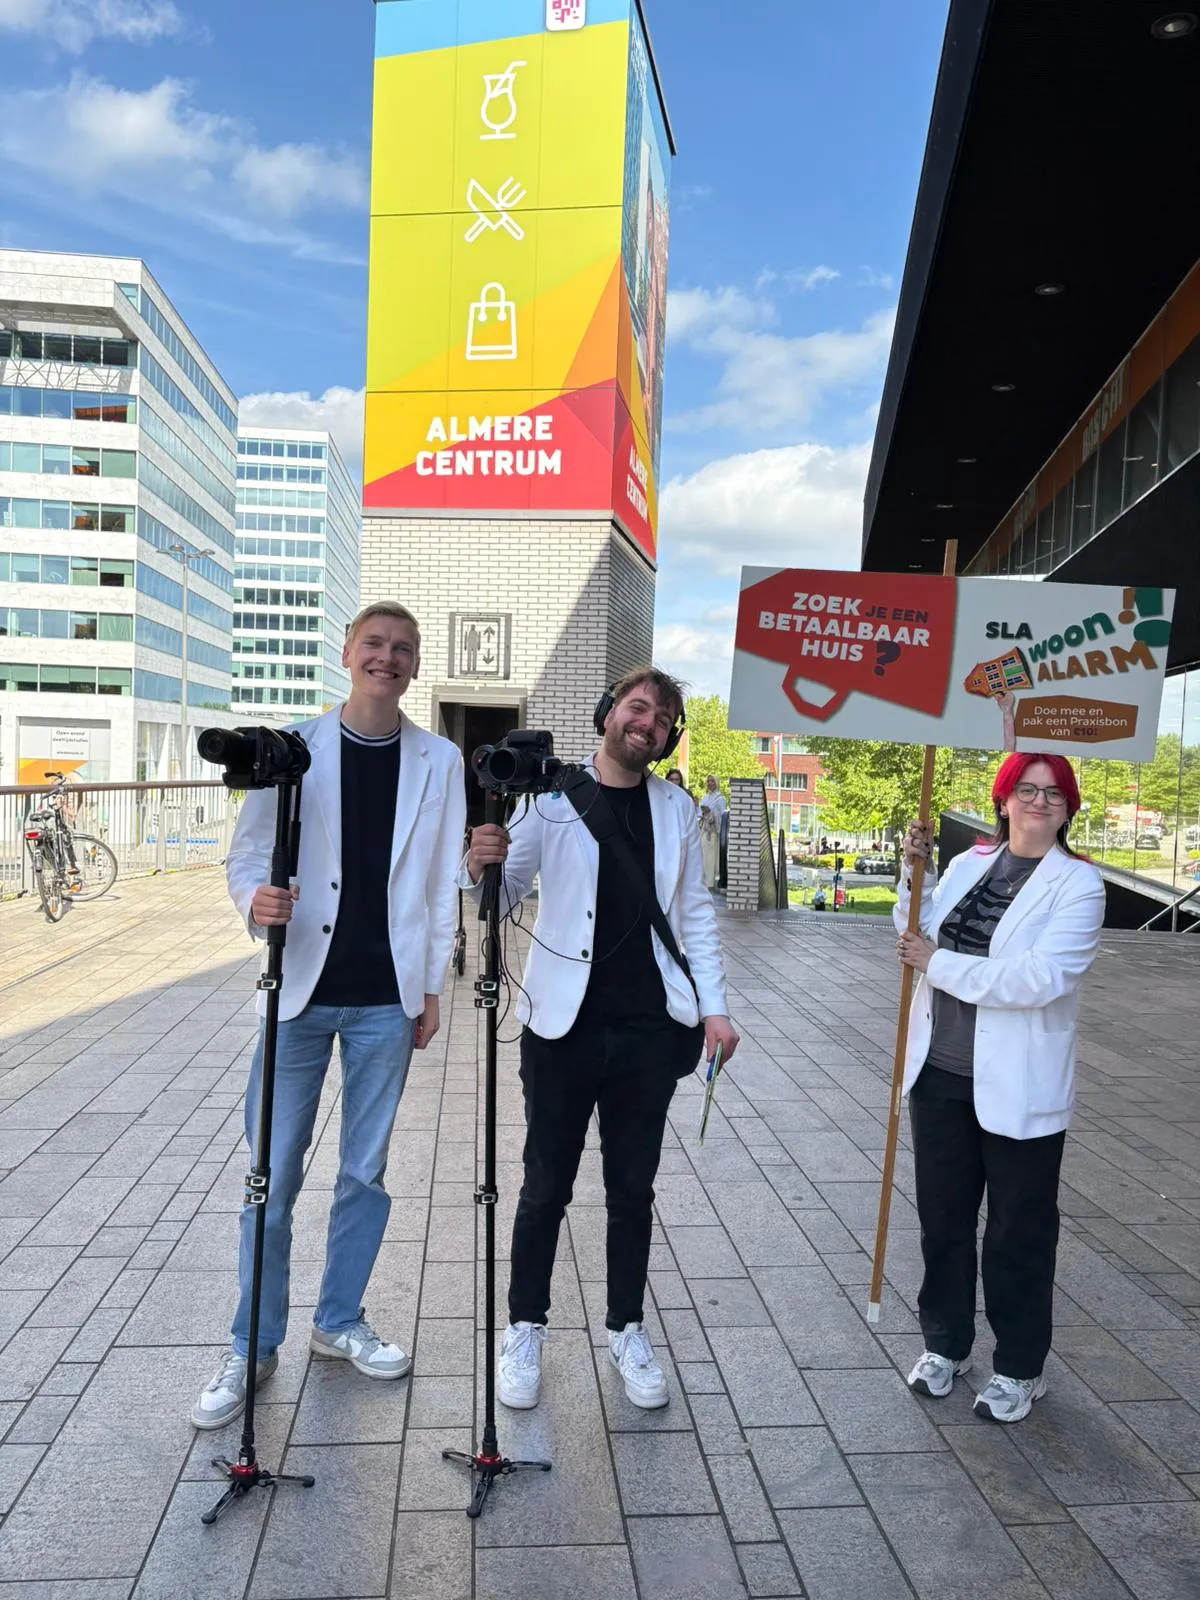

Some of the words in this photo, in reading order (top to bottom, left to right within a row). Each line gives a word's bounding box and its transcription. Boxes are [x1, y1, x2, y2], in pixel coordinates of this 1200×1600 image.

[426, 415, 553, 442] ALMERE
[416, 449, 562, 476] CENTRUM
[792, 592, 863, 617] ZOEK
[865, 606, 887, 619] JE
[891, 608, 929, 624] EEN
[758, 611, 930, 647] BETAALBAAR
[985, 621, 1034, 641] SLA
[801, 638, 864, 662] HUIS
[873, 640, 901, 677] ?
[1037, 640, 1158, 683] ALARM
[1022, 716, 1043, 728] pak
[1046, 718, 1067, 726] een
[1070, 717, 1128, 727] Praxisbon
[1034, 706, 1058, 716] Doe
[1060, 707, 1085, 716] mee
[1088, 707, 1104, 716] en
[1050, 728, 1071, 737] van
